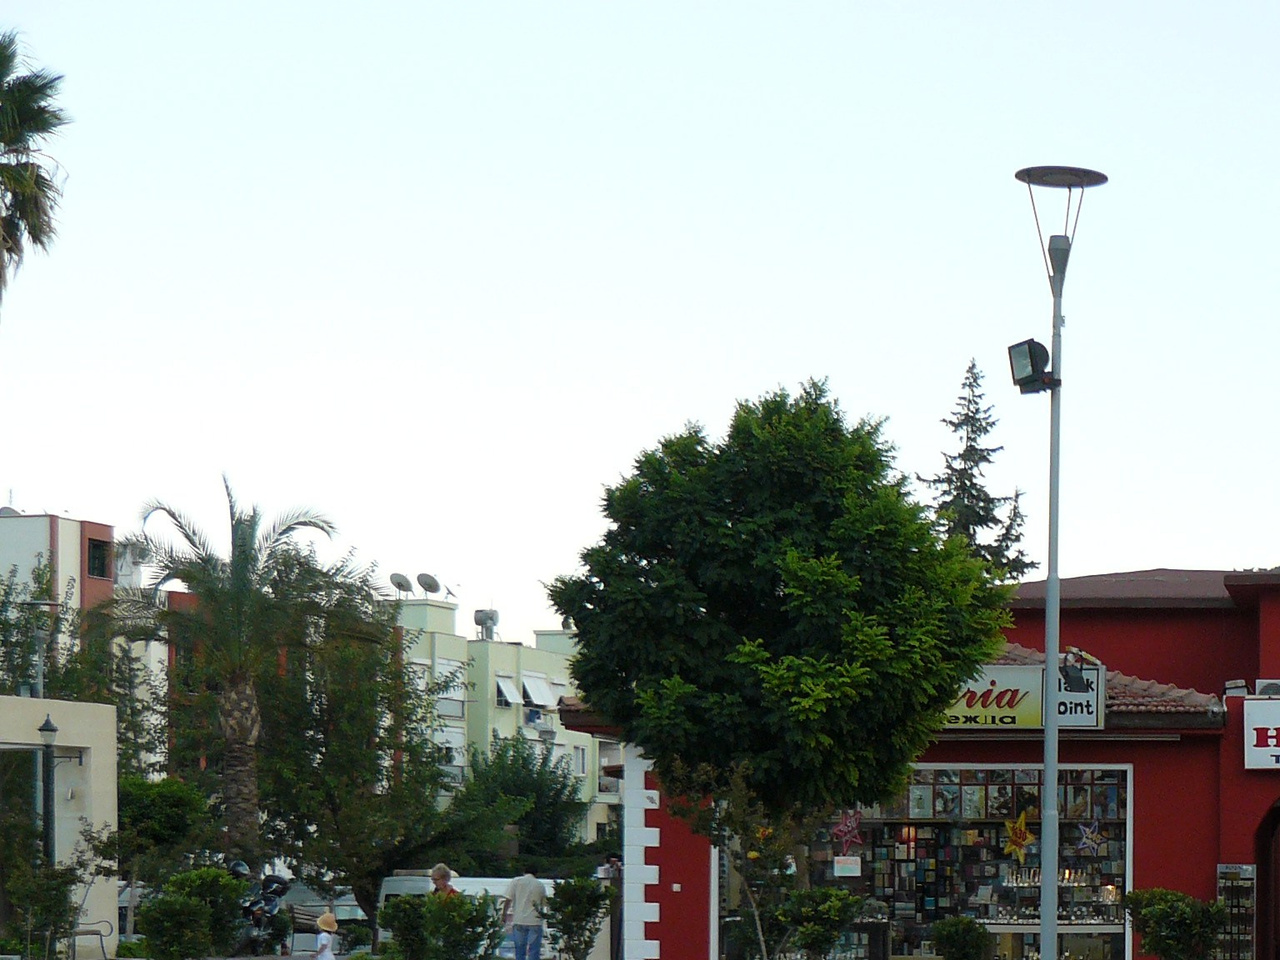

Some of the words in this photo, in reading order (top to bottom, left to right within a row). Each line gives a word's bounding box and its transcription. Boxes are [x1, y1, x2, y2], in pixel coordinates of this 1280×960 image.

[1058, 677, 1095, 693] lak
[952, 679, 1029, 709] ria
[1058, 700, 1094, 715] oint
[947, 715, 1017, 726] ежда
